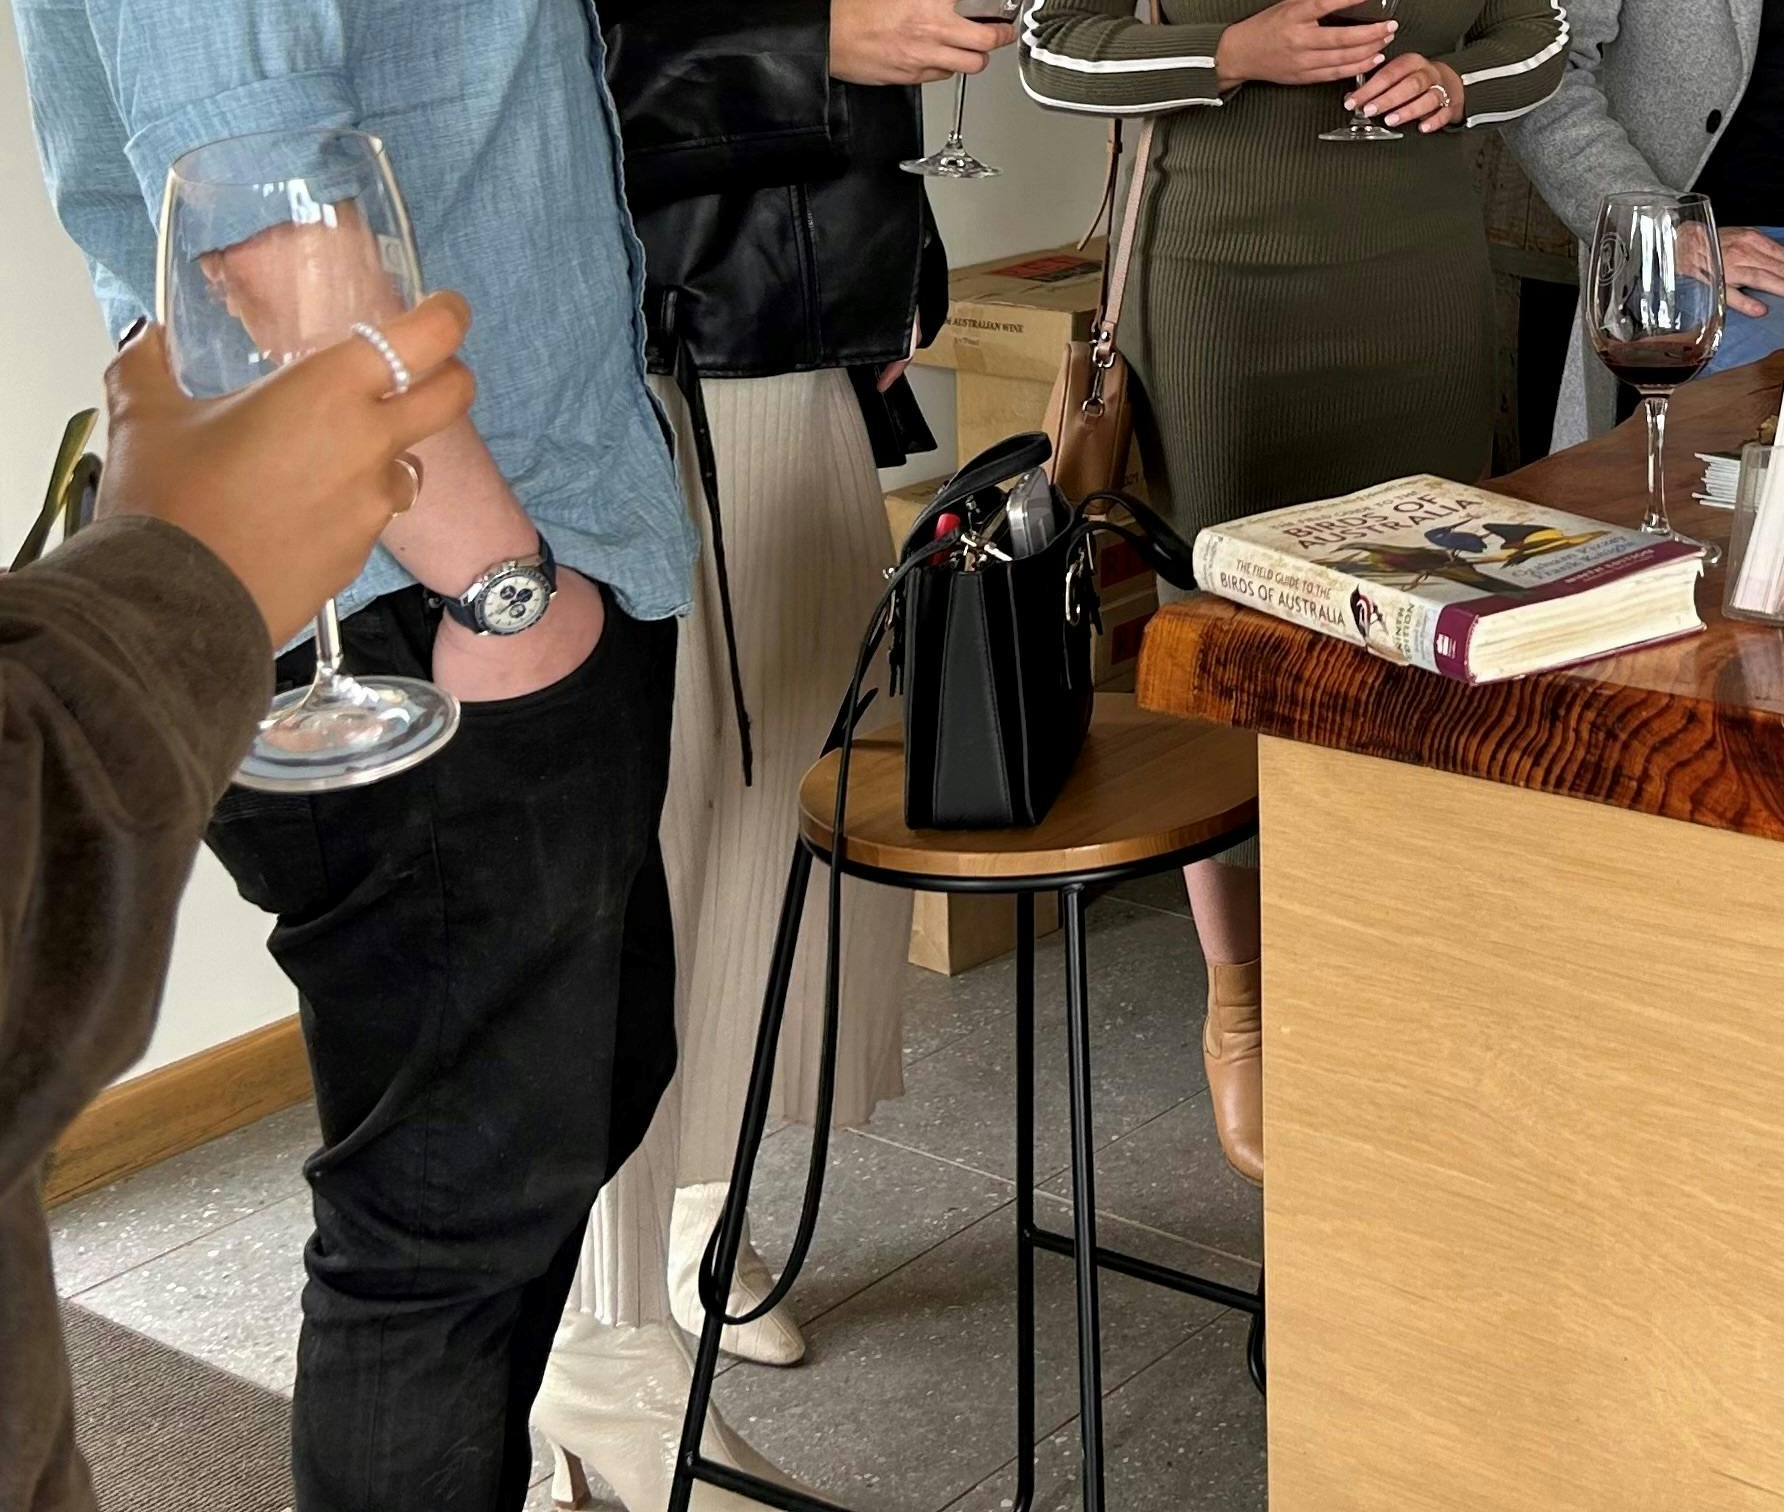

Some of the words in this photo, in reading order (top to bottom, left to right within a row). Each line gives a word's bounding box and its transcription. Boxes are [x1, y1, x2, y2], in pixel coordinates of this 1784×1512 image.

[953, 317, 1001, 332] AUSTRALIAN
[1283, 511, 1389, 538] BIRDS
[1393, 493, 1439, 513] OF
[1298, 498, 1484, 550] AUSTRALIA
[1220, 571, 1255, 597] BIRDS
[1258, 584, 1275, 603] OF
[1278, 591, 1346, 627] AUSTRALIA
[1237, 559, 1252, 575] THE
[1253, 564, 1274, 581] FIELD
[1275, 571, 1300, 590] GUIDE
[1303, 580, 1314, 594] TO
[1315, 583, 1332, 601] THE
